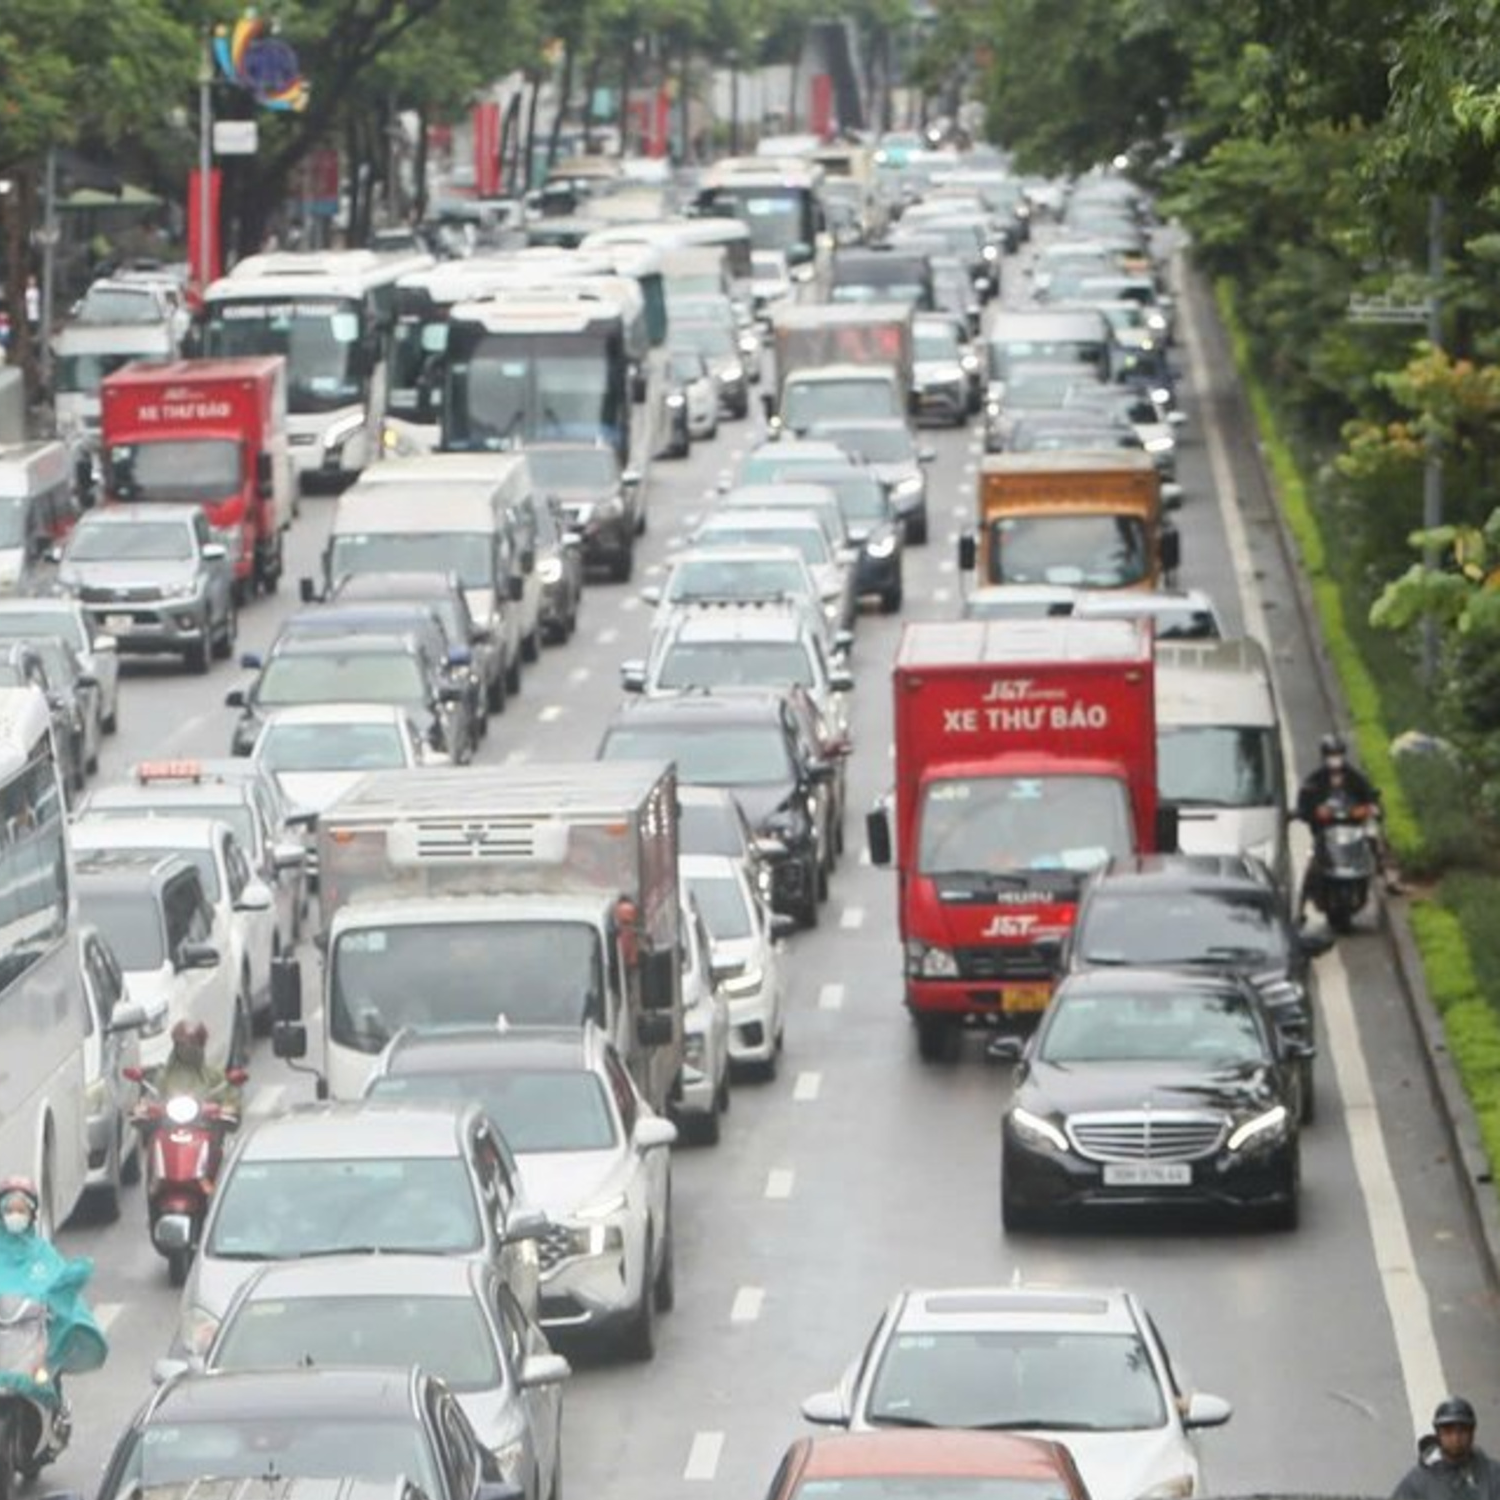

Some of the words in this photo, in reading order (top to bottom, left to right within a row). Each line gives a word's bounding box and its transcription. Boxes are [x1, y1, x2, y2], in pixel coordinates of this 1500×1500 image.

[983, 680, 1032, 701] J&T
[944, 709, 977, 732] XE
[985, 707, 1046, 731] THƯ
[1051, 700, 1107, 730] BÁO
[982, 915, 1039, 937] J&T
